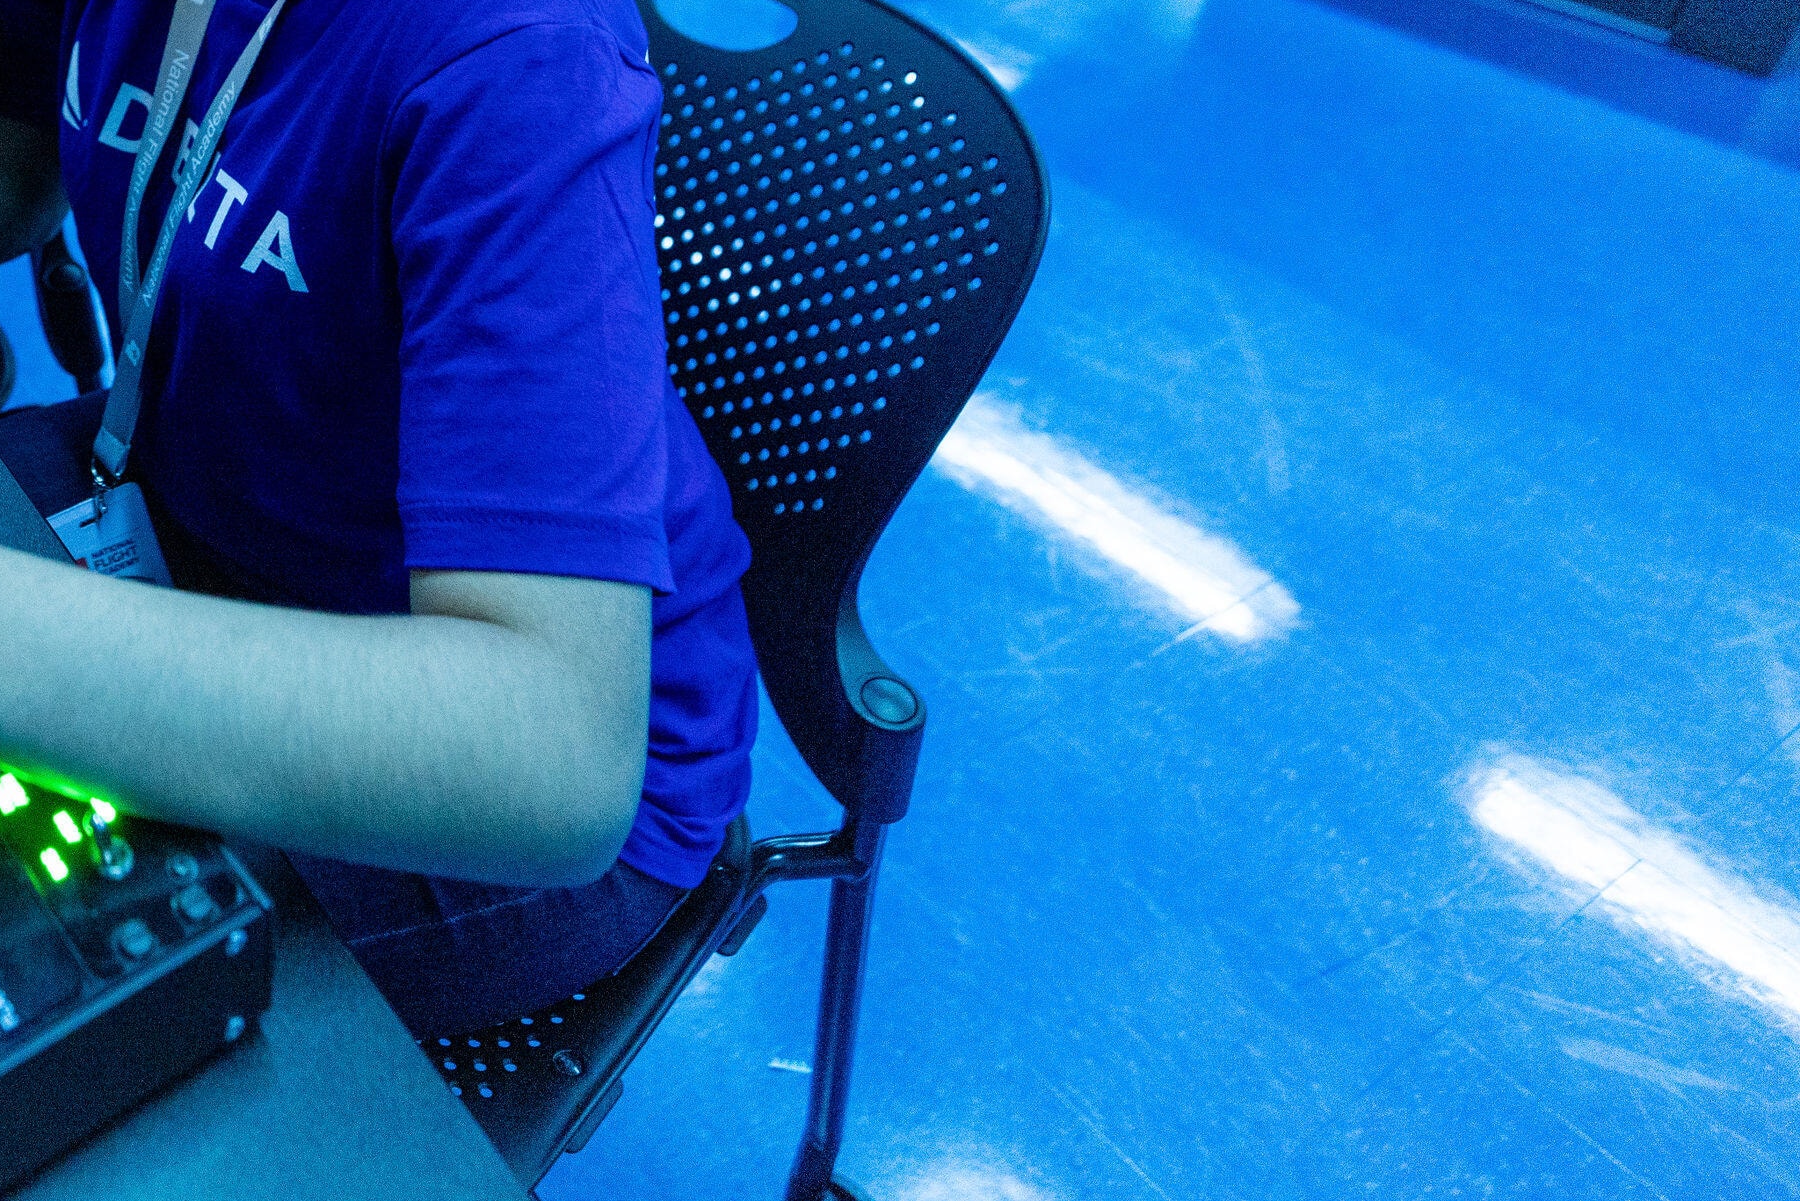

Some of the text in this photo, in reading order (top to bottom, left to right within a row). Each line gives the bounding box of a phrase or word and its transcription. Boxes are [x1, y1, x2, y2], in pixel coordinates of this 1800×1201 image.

[152, 50, 189, 137] National
[142, 80, 236, 307] National Flight Academy
[94, 546, 138, 570] FLIGHT
